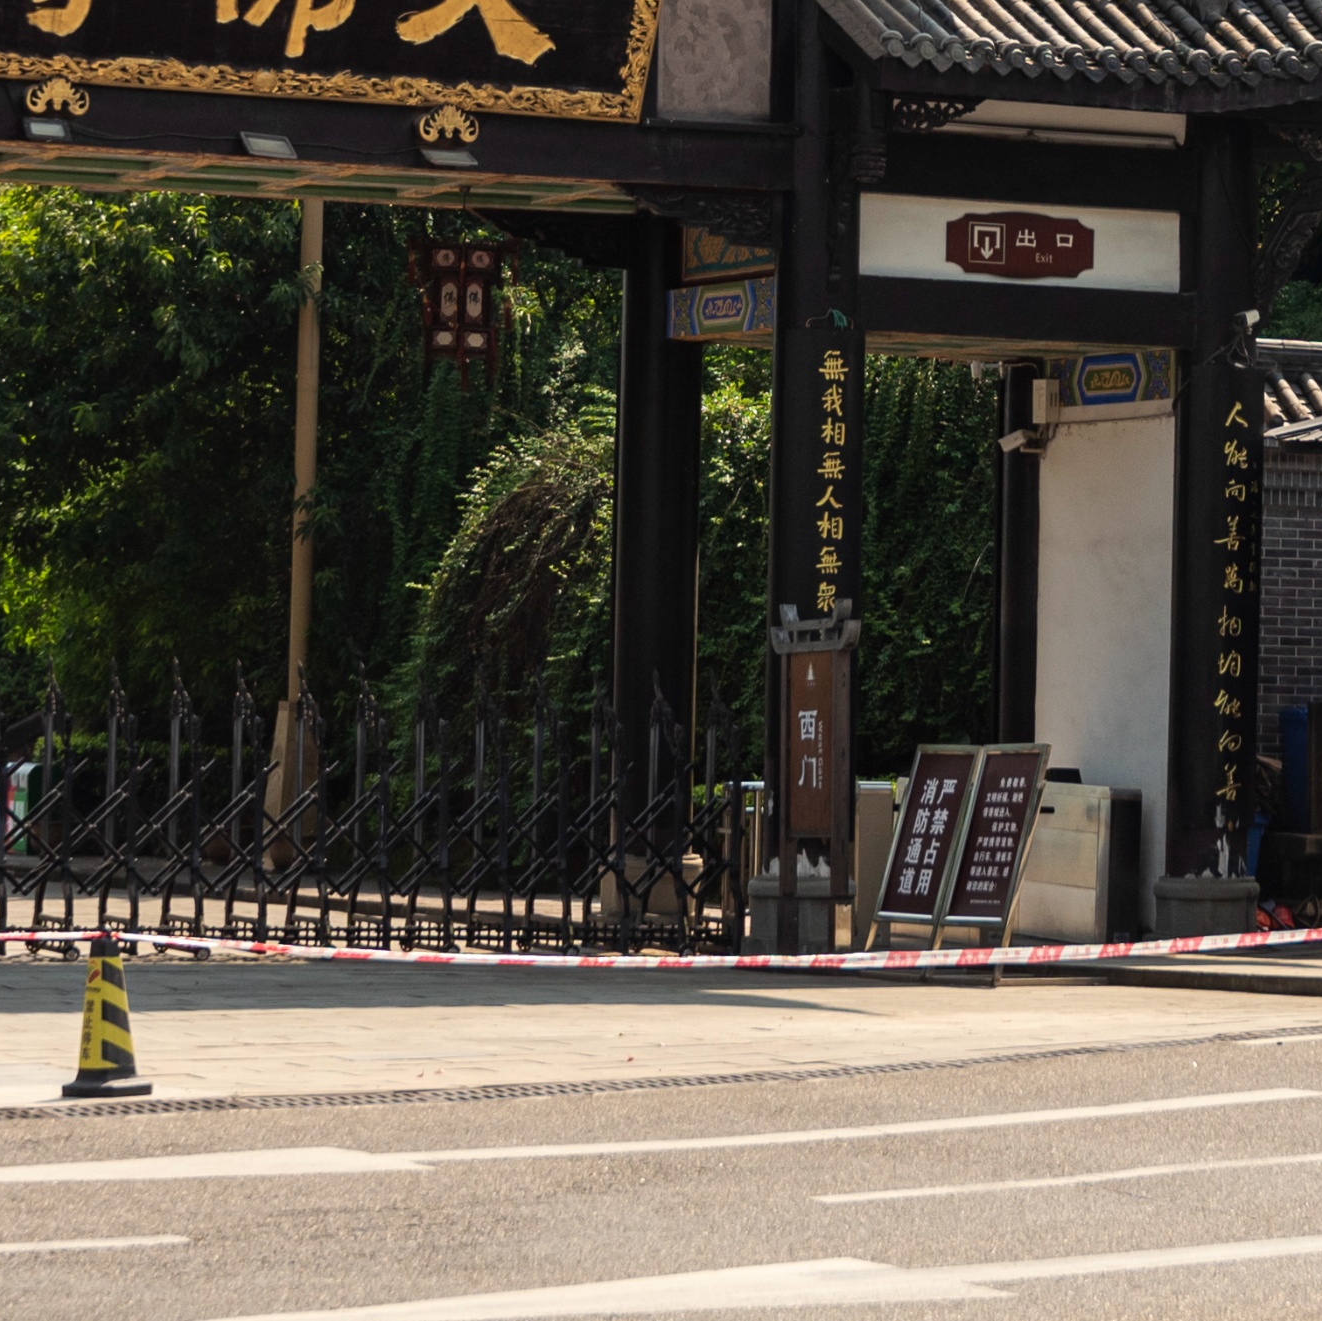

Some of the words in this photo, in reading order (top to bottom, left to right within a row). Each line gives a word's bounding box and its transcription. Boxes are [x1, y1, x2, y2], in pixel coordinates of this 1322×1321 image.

[1016, 228, 1074, 248] 出口
[1035, 252, 1053, 264] Exit
[798, 709, 818, 788] 西门
[897, 777, 939, 894] 消防通道
[915, 778, 958, 895] 严禁占用
